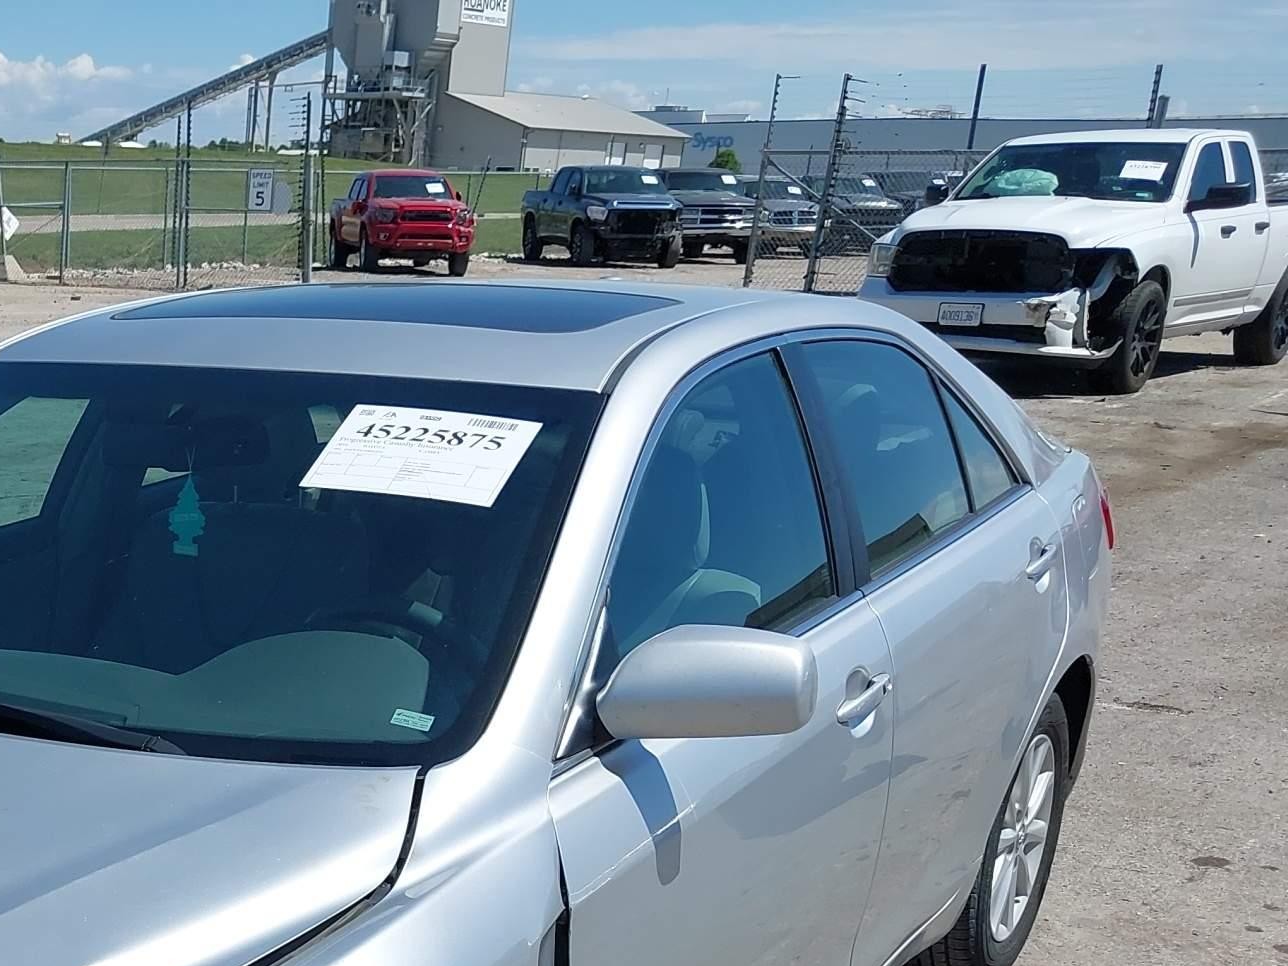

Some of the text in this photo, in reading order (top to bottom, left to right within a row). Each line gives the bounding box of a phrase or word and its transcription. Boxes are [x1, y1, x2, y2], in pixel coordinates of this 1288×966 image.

[692, 132, 734, 151] Sysco
[255, 191, 265, 206] 5
[356, 423, 506, 451] 45225875
